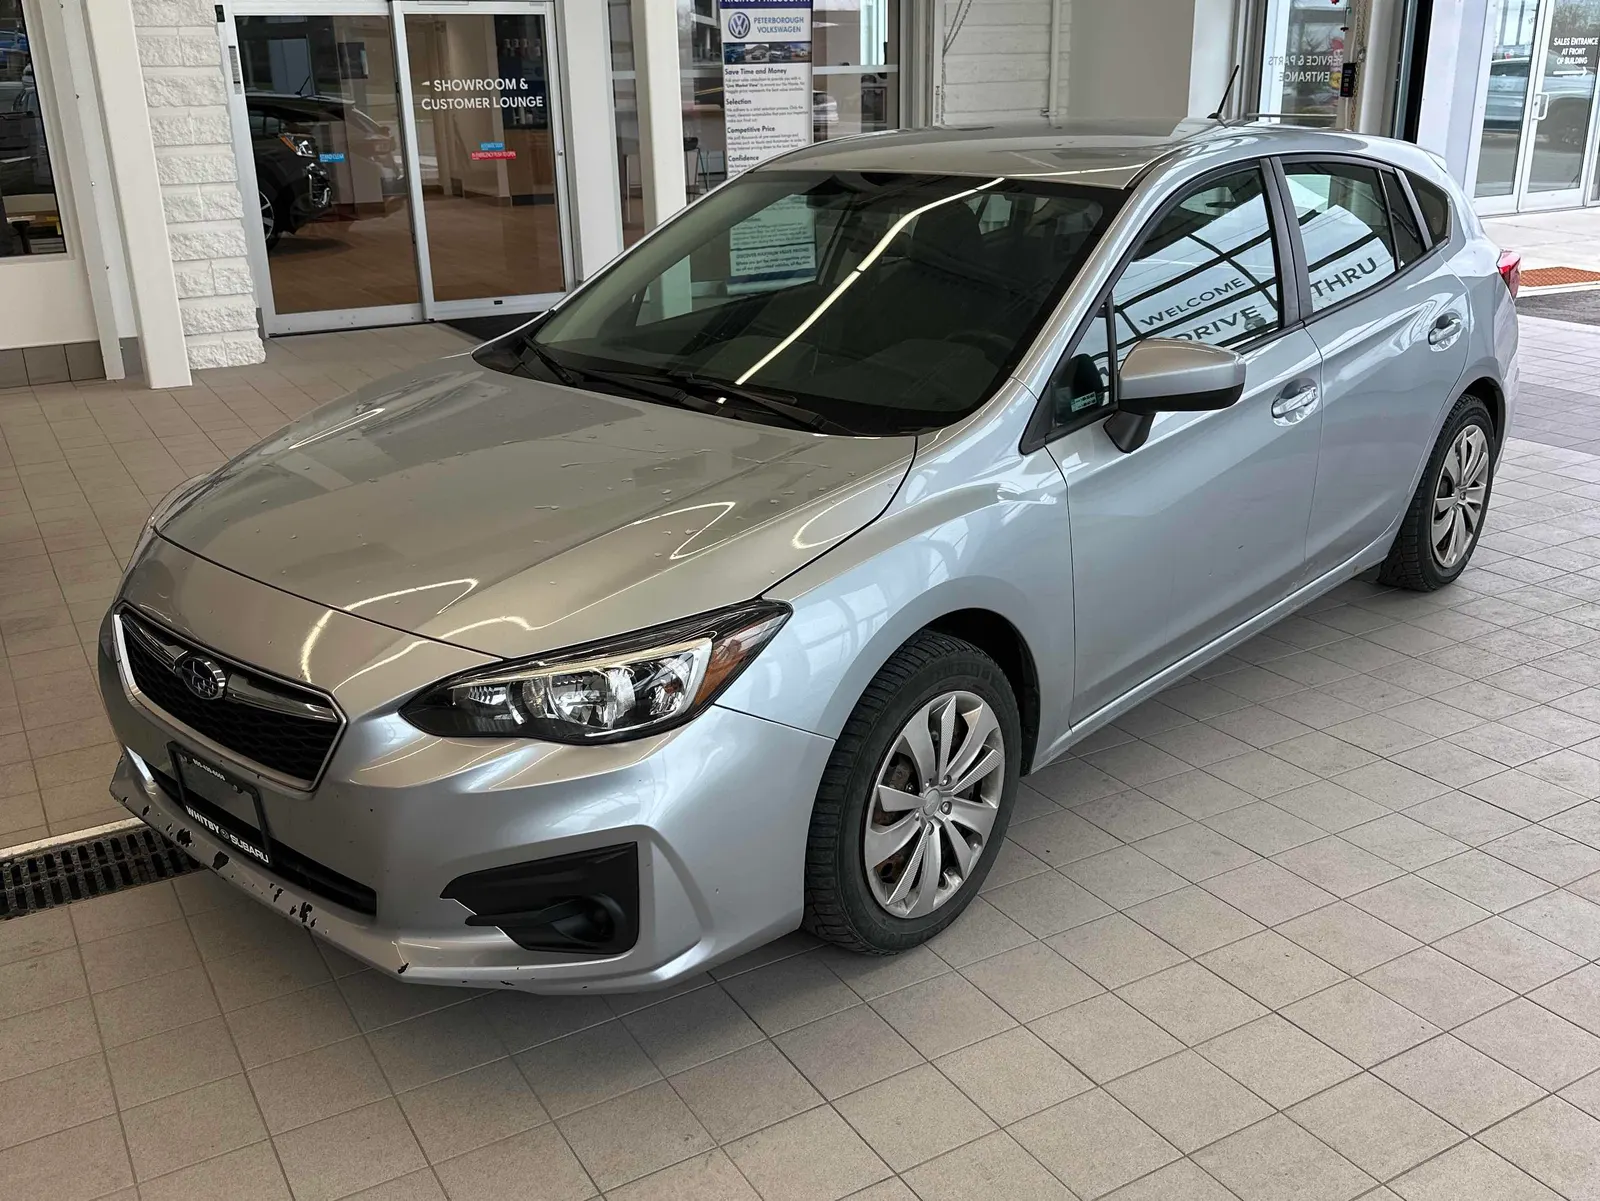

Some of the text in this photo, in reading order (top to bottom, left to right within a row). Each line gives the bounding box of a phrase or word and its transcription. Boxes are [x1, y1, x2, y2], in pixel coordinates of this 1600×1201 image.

[753, 16, 804, 24] PETERBOROUGH
[756, 25, 802, 34] VOLKSWAGEN
[1553, 36, 1599, 46] SALES ENTRANCE
[1569, 47, 1586, 55] FRONT
[1556, 56, 1588, 65] OF BUILDING
[725, 68, 739, 76] Save
[767, 67, 787, 75] Money
[434, 77, 529, 92] SHOWROOM &
[421, 96, 544, 111] CUSTOMER LOUNGE
[727, 126, 761, 134] Competitive
[728, 154, 759, 162] Confidence
[1311, 257, 1378, 298] THRU
[1140, 277, 1246, 327] WELCOME
[185, 805, 270, 864] WHITBY SUBARU
